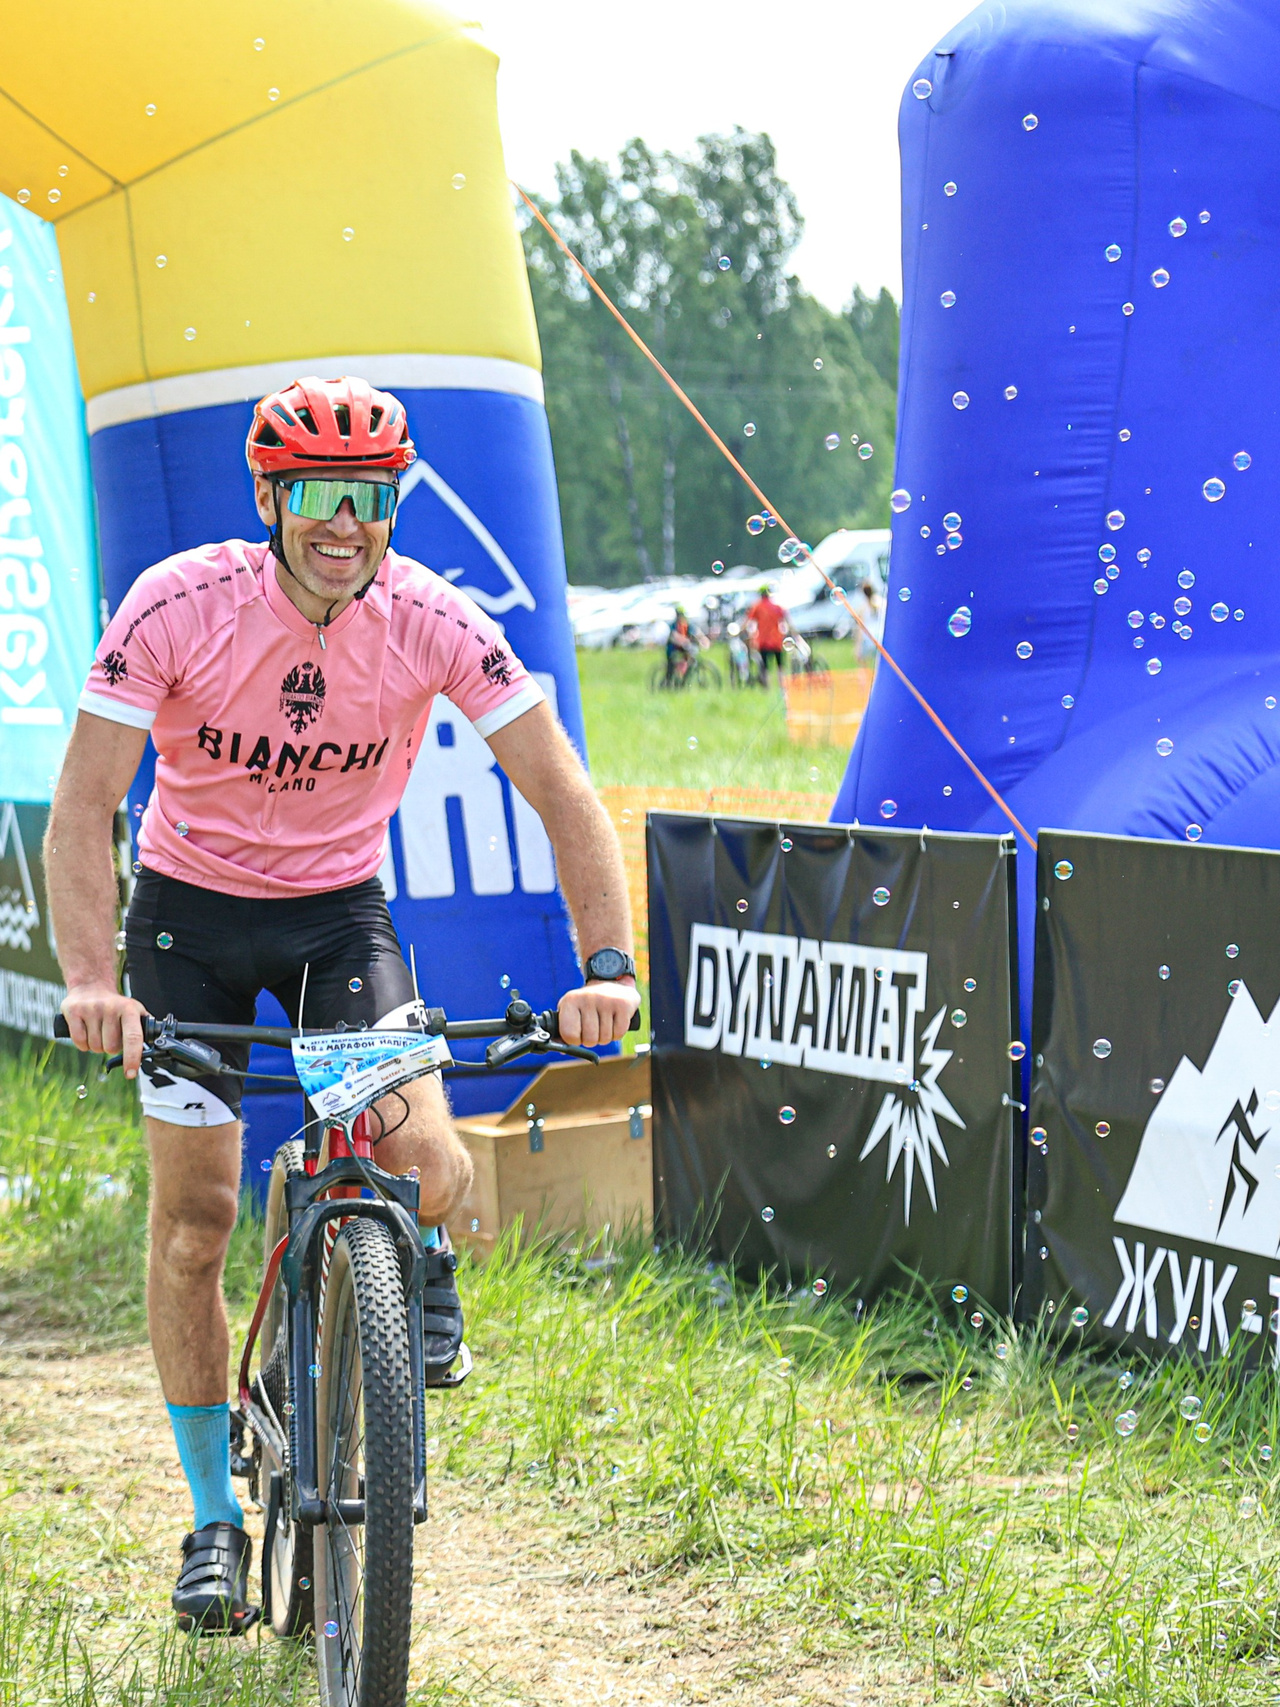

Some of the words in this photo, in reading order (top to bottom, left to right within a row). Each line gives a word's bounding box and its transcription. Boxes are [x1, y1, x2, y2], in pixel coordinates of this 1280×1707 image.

[196, 583, 209, 591] 1923
[198, 722, 389, 778] BIANCHI
[249, 772, 316, 793] MILANO
[326, 1041, 375, 1051] МАРАФОН
